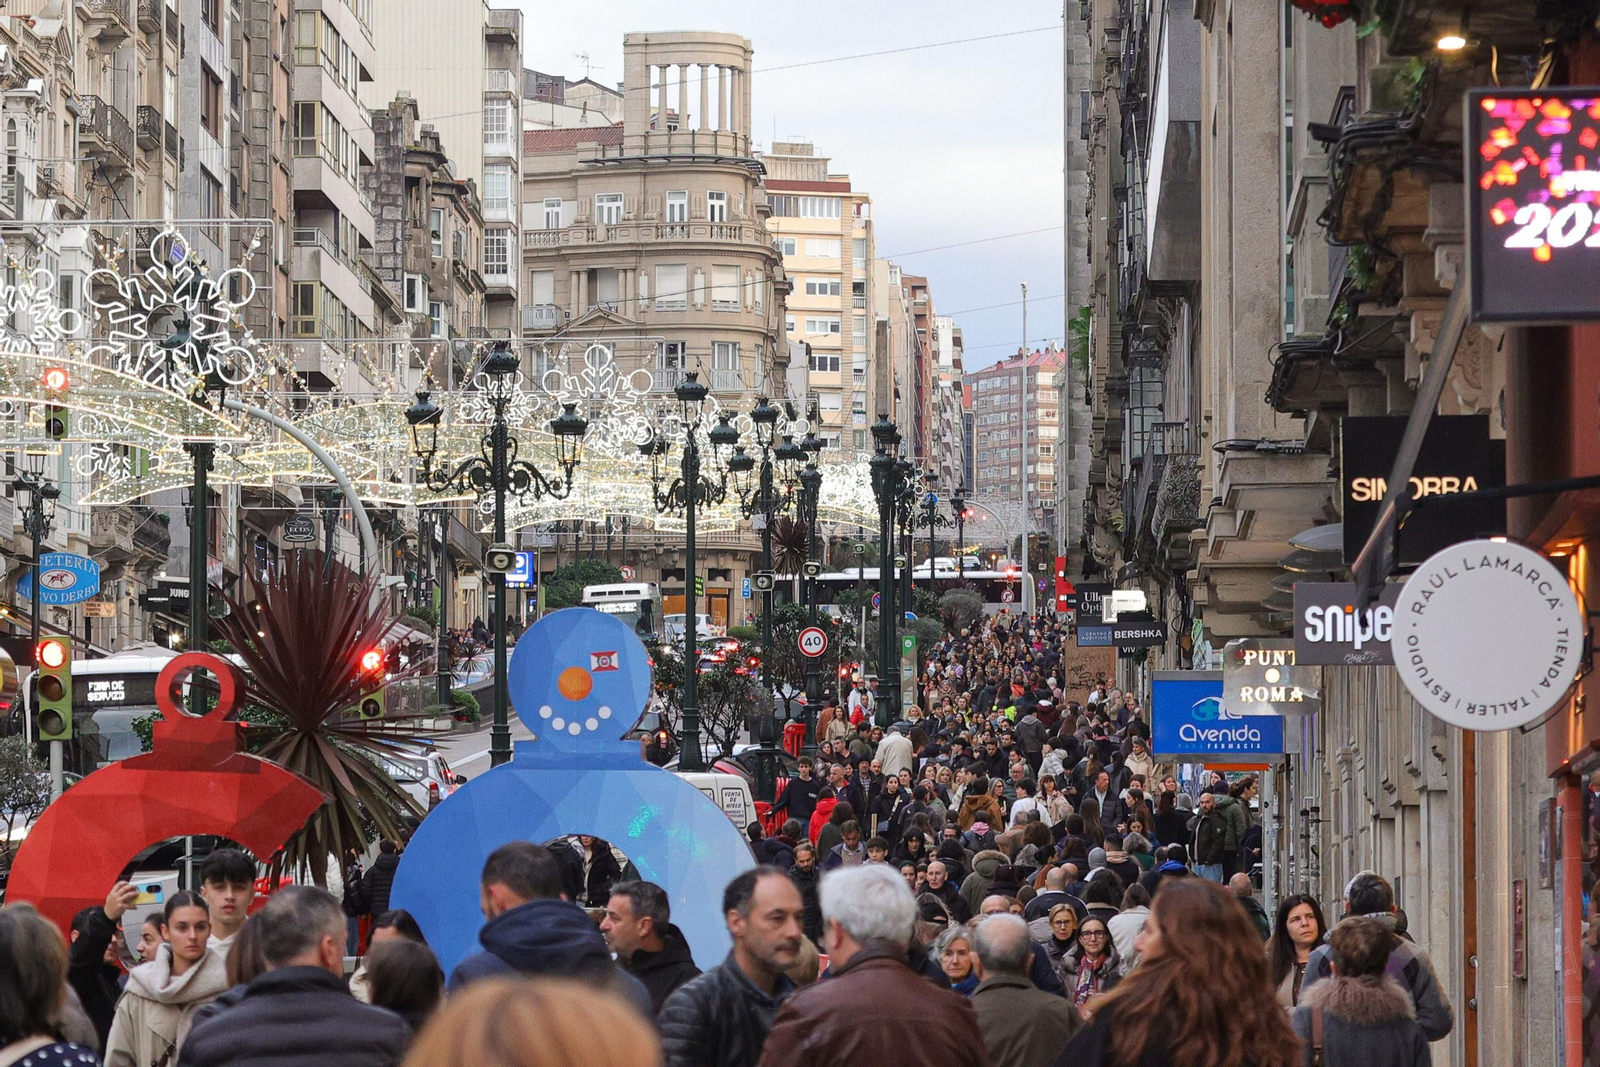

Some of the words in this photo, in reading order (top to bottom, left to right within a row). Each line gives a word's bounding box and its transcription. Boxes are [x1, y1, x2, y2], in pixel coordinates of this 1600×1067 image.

[61, 583, 97, 602] DERBY
[1462, 555, 1561, 610] LAMARCA
[1114, 630, 1163, 639] BERSHKA
[1304, 605, 1394, 650] snipe
[804, 636, 821, 647] 40
[1538, 628, 1569, 688] TIENDA
[1407, 635, 1451, 703] ESTUDIO
[1240, 686, 1304, 702] ROMA
[1466, 696, 1530, 716] TALLER
